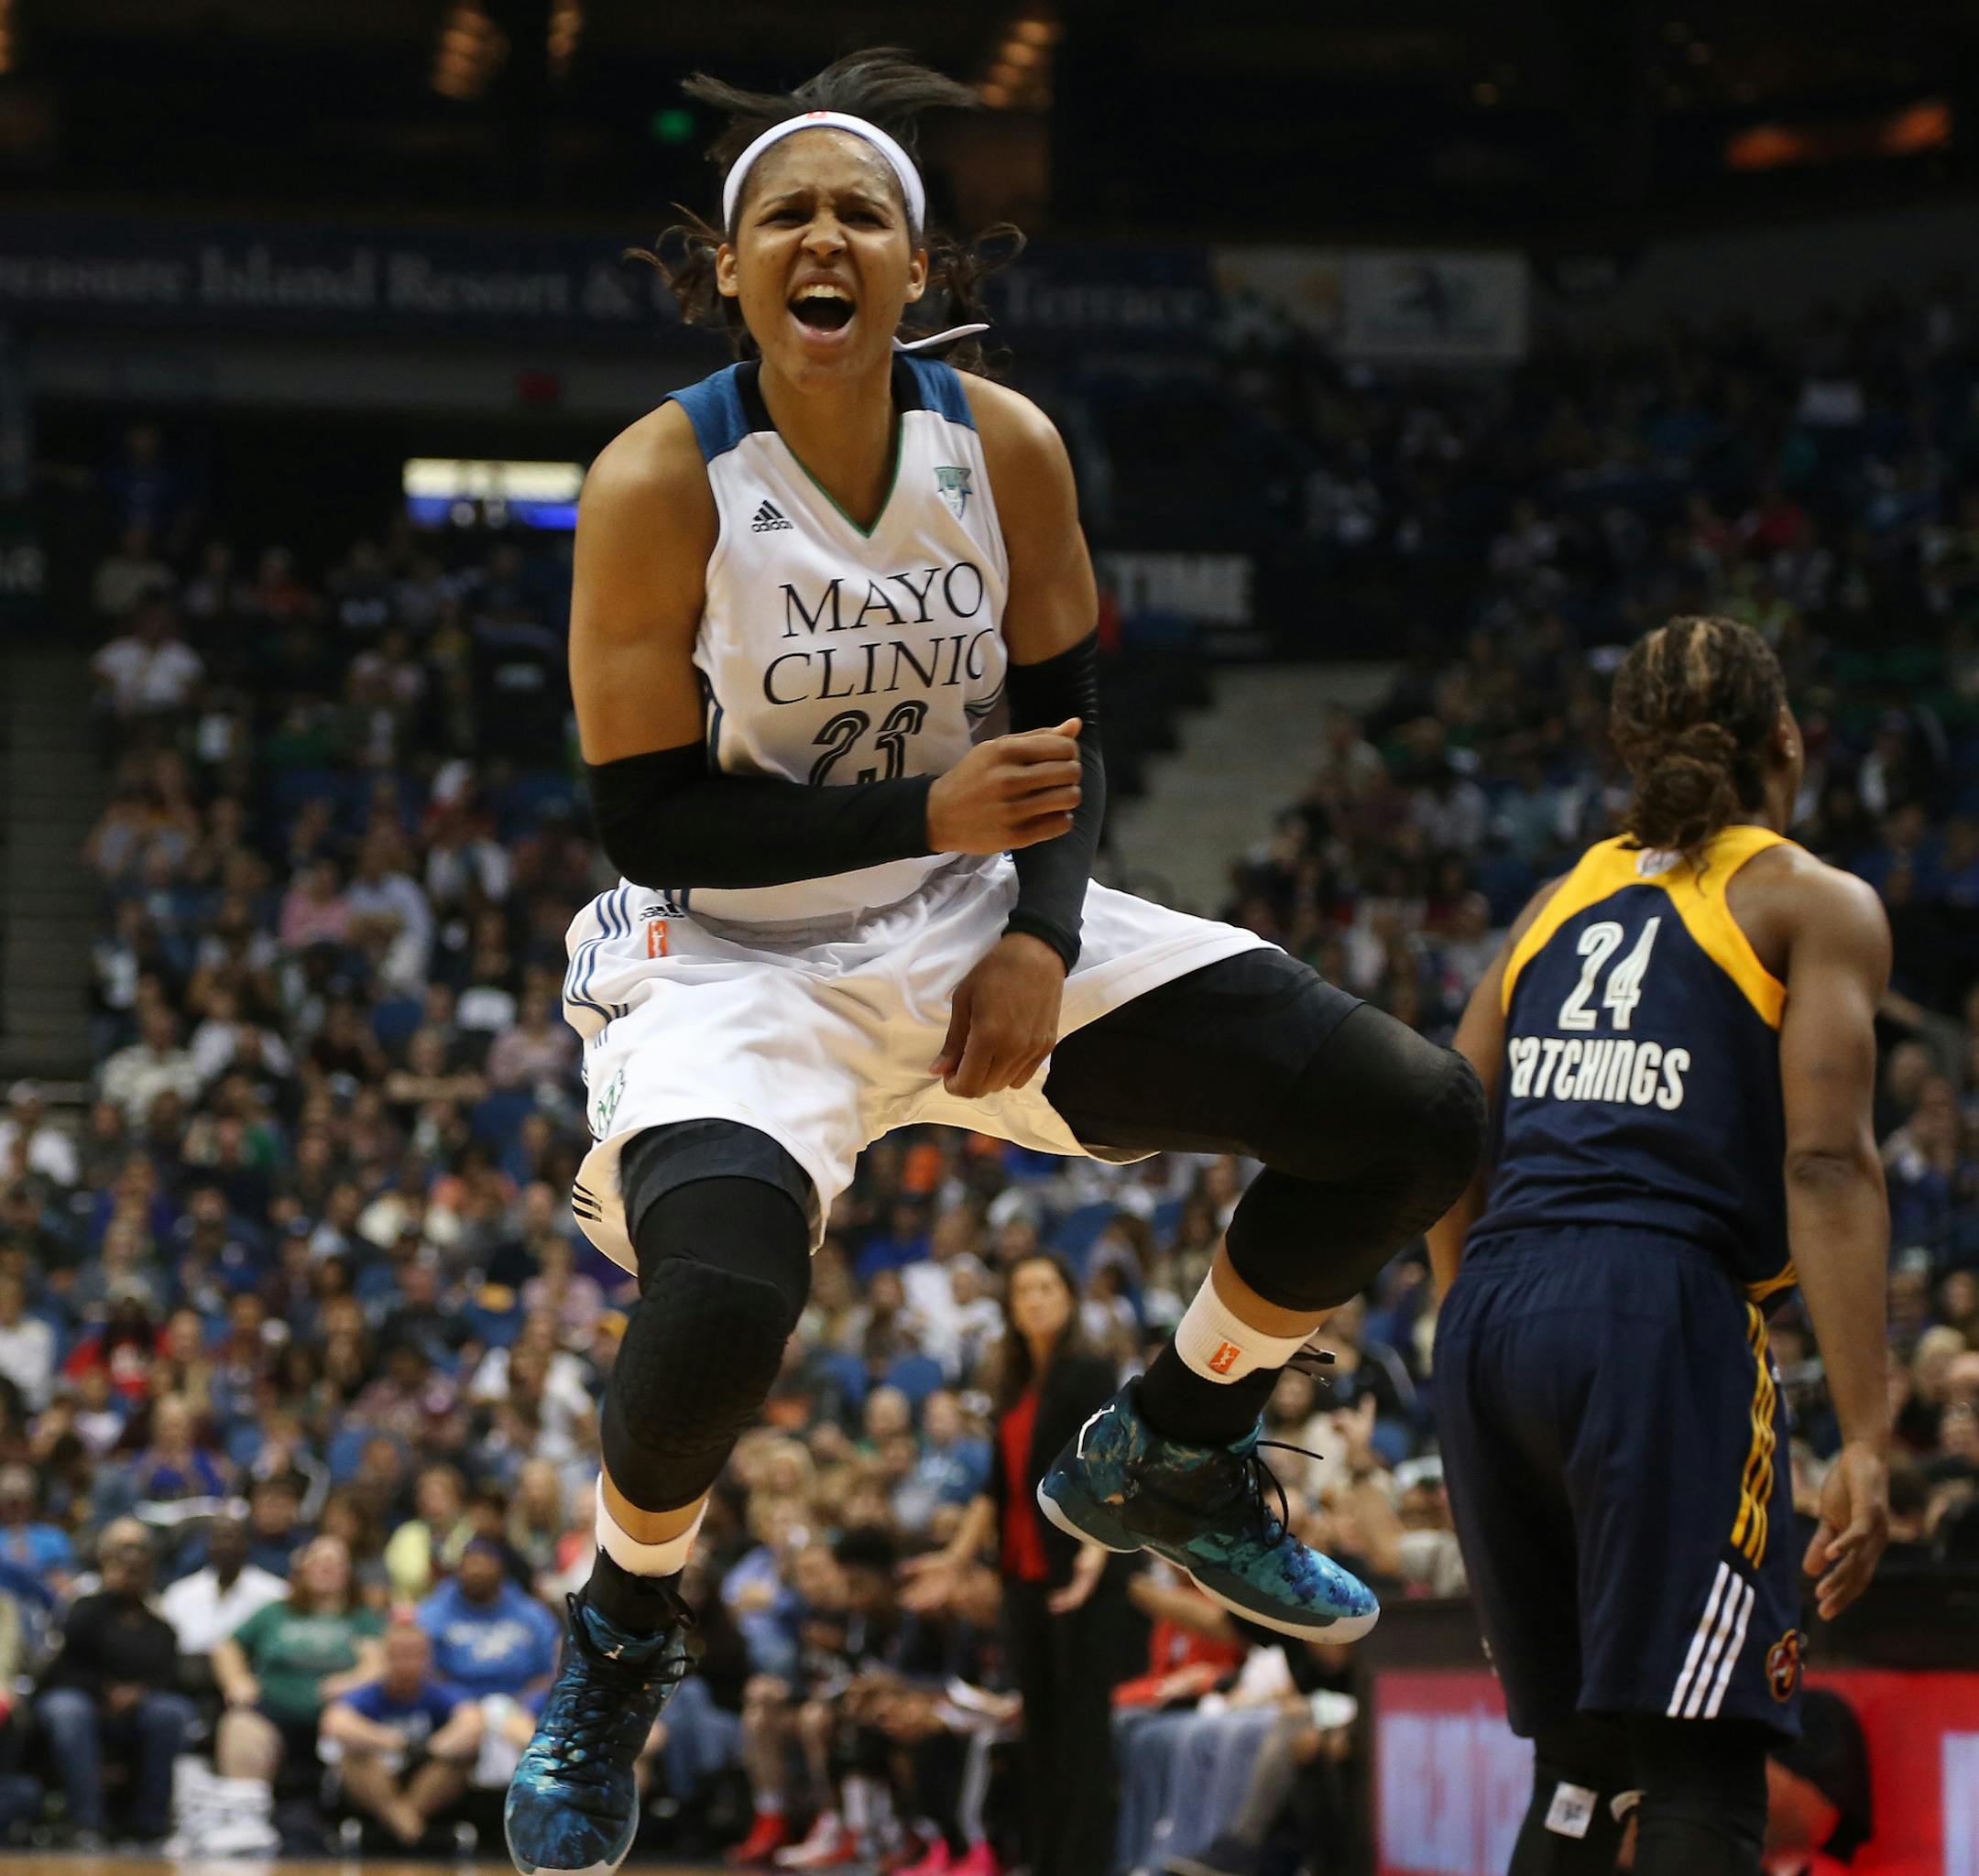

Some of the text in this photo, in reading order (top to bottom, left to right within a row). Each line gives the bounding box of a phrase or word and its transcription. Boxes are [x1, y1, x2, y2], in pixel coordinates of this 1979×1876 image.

[779, 562, 984, 638] MAYO
[763, 628, 994, 704] CLINIC
[809, 700, 929, 786] 23
[1558, 916, 1662, 1031] 24
